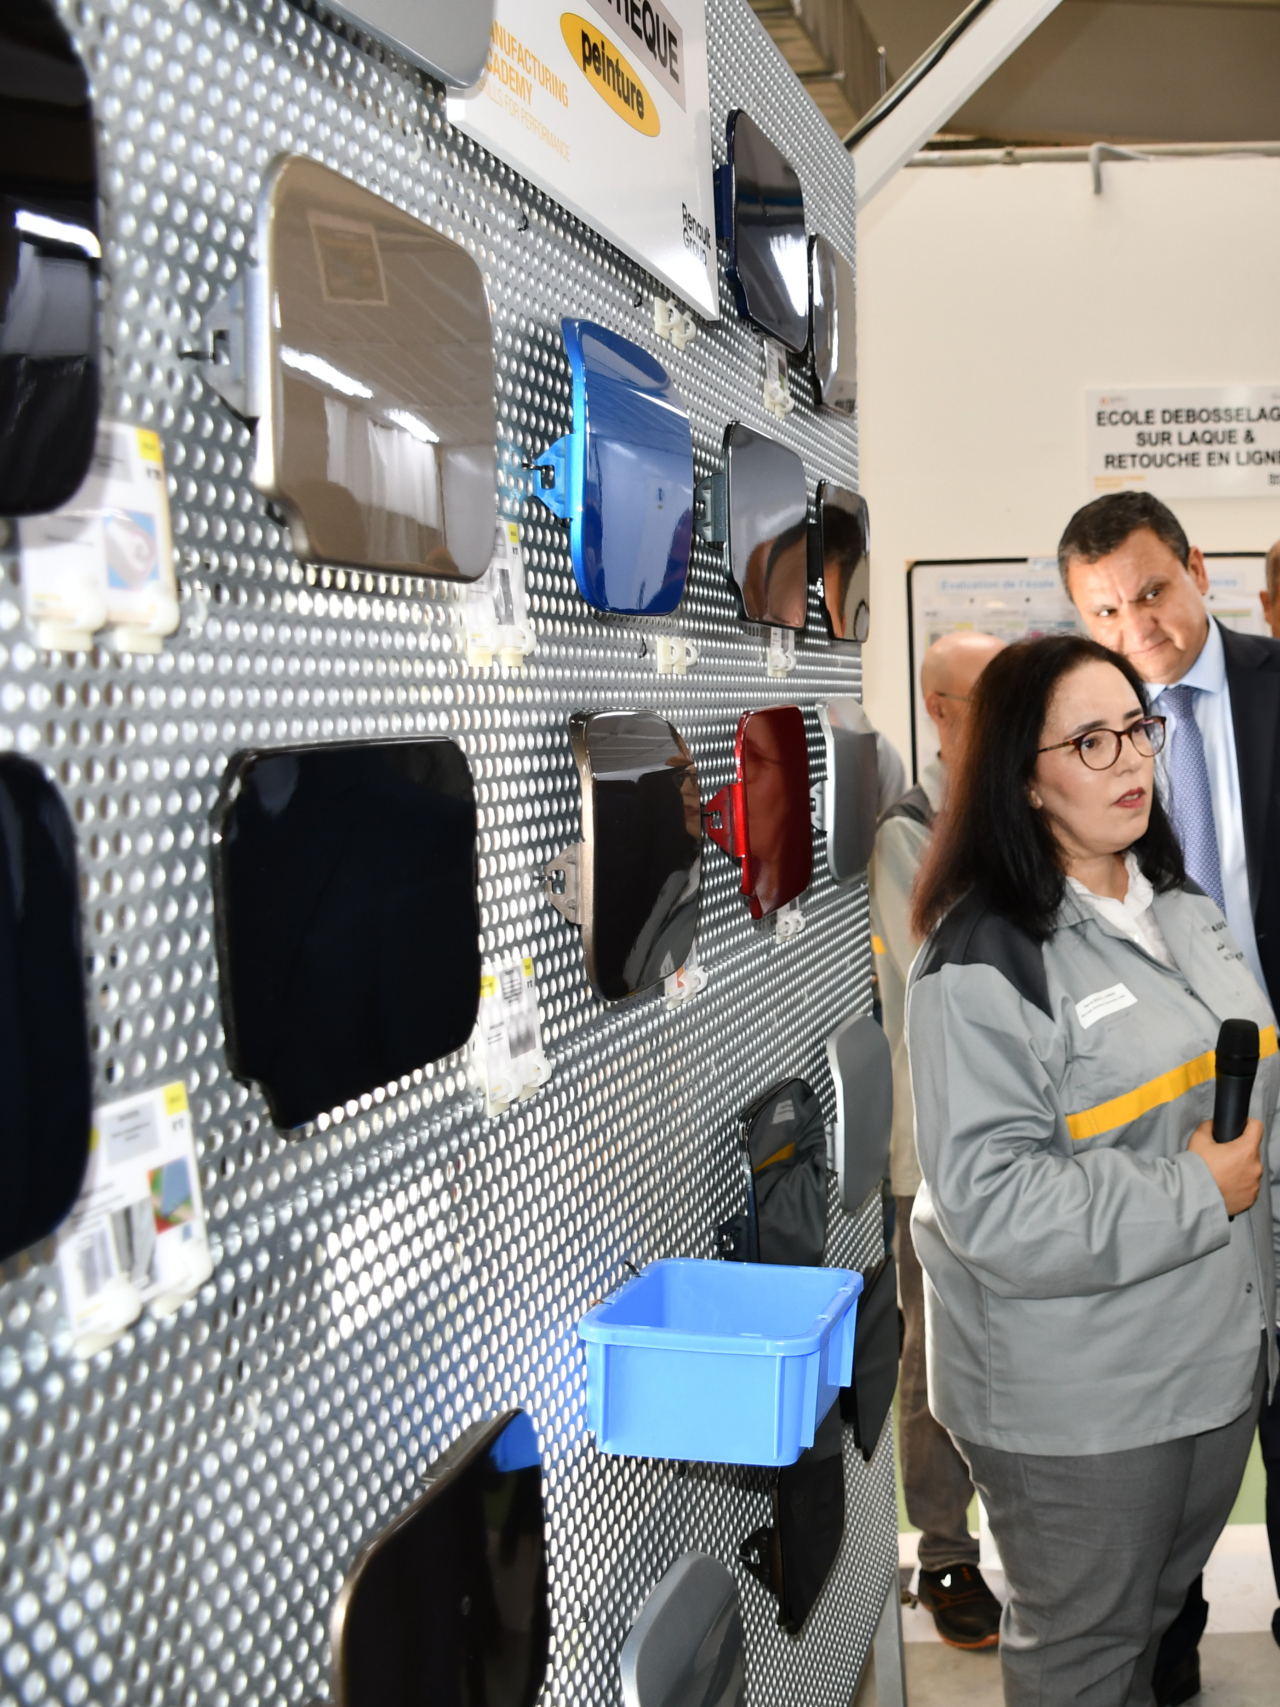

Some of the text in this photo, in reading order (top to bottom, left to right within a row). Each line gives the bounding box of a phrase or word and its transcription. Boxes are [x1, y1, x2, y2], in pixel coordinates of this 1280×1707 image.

[485, 48, 533, 107] CADEMY
[490, 20, 569, 108] ANUFACTURING
[581, 29, 644, 120] peinture
[504, 94, 520, 121] FOR
[521, 107, 571, 163] PERFORMANCE
[682, 201, 711, 251] Renault
[683, 226, 708, 267] Group
[1096, 409, 1156, 426] ECOLE
[1136, 429, 1255, 447] SUR LAQUE &
[1104, 453, 1201, 469] RETOUCHE
[1207, 452, 1230, 467] EN
